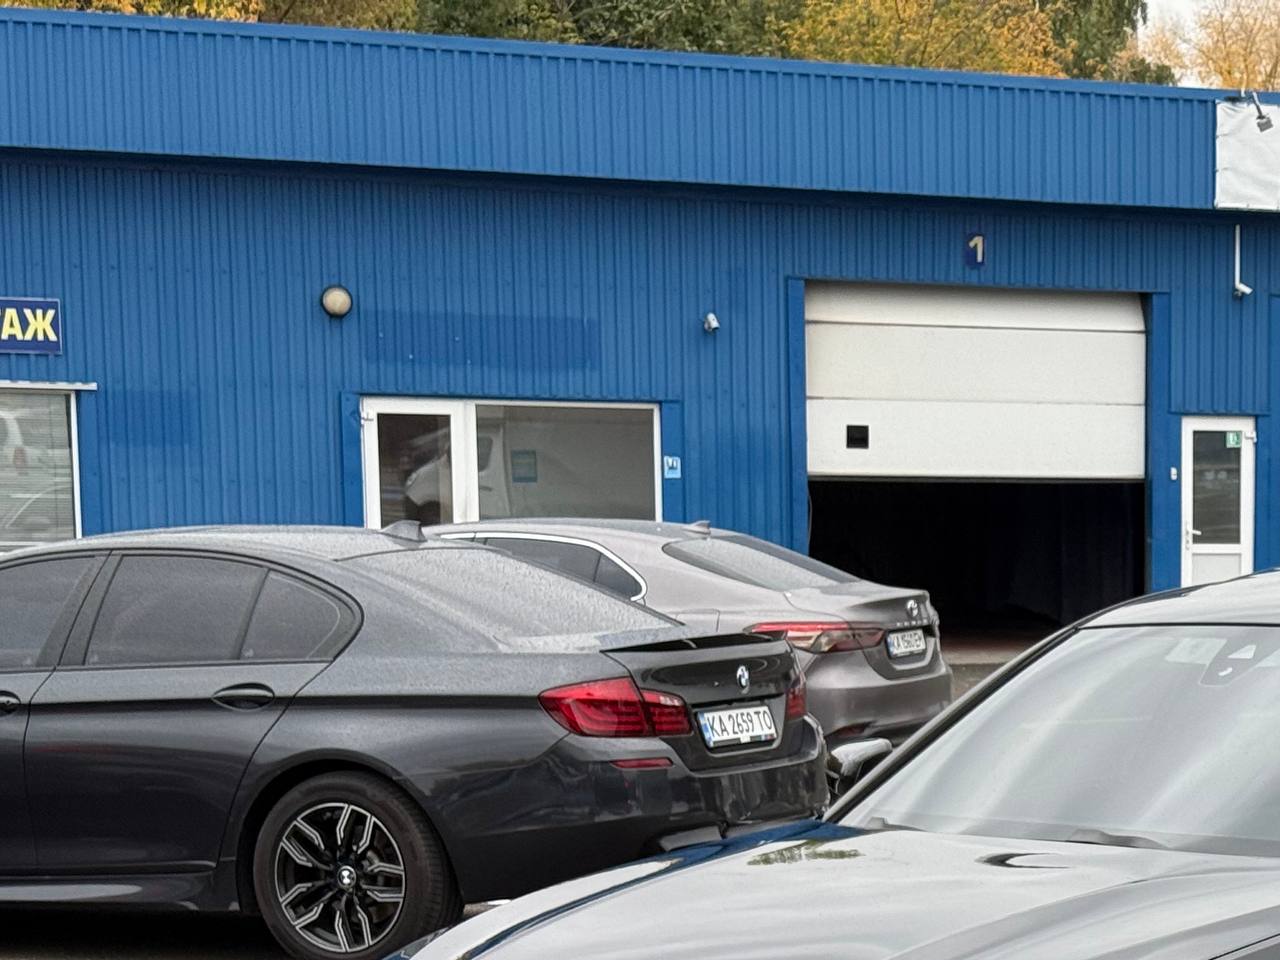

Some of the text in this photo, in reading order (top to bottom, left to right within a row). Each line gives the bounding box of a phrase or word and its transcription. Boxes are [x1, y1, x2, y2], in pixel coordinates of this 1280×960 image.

[968, 235, 984, 263] 1
[0, 308, 58, 342] АЖ
[707, 710, 773, 738] KA 2659 TO
